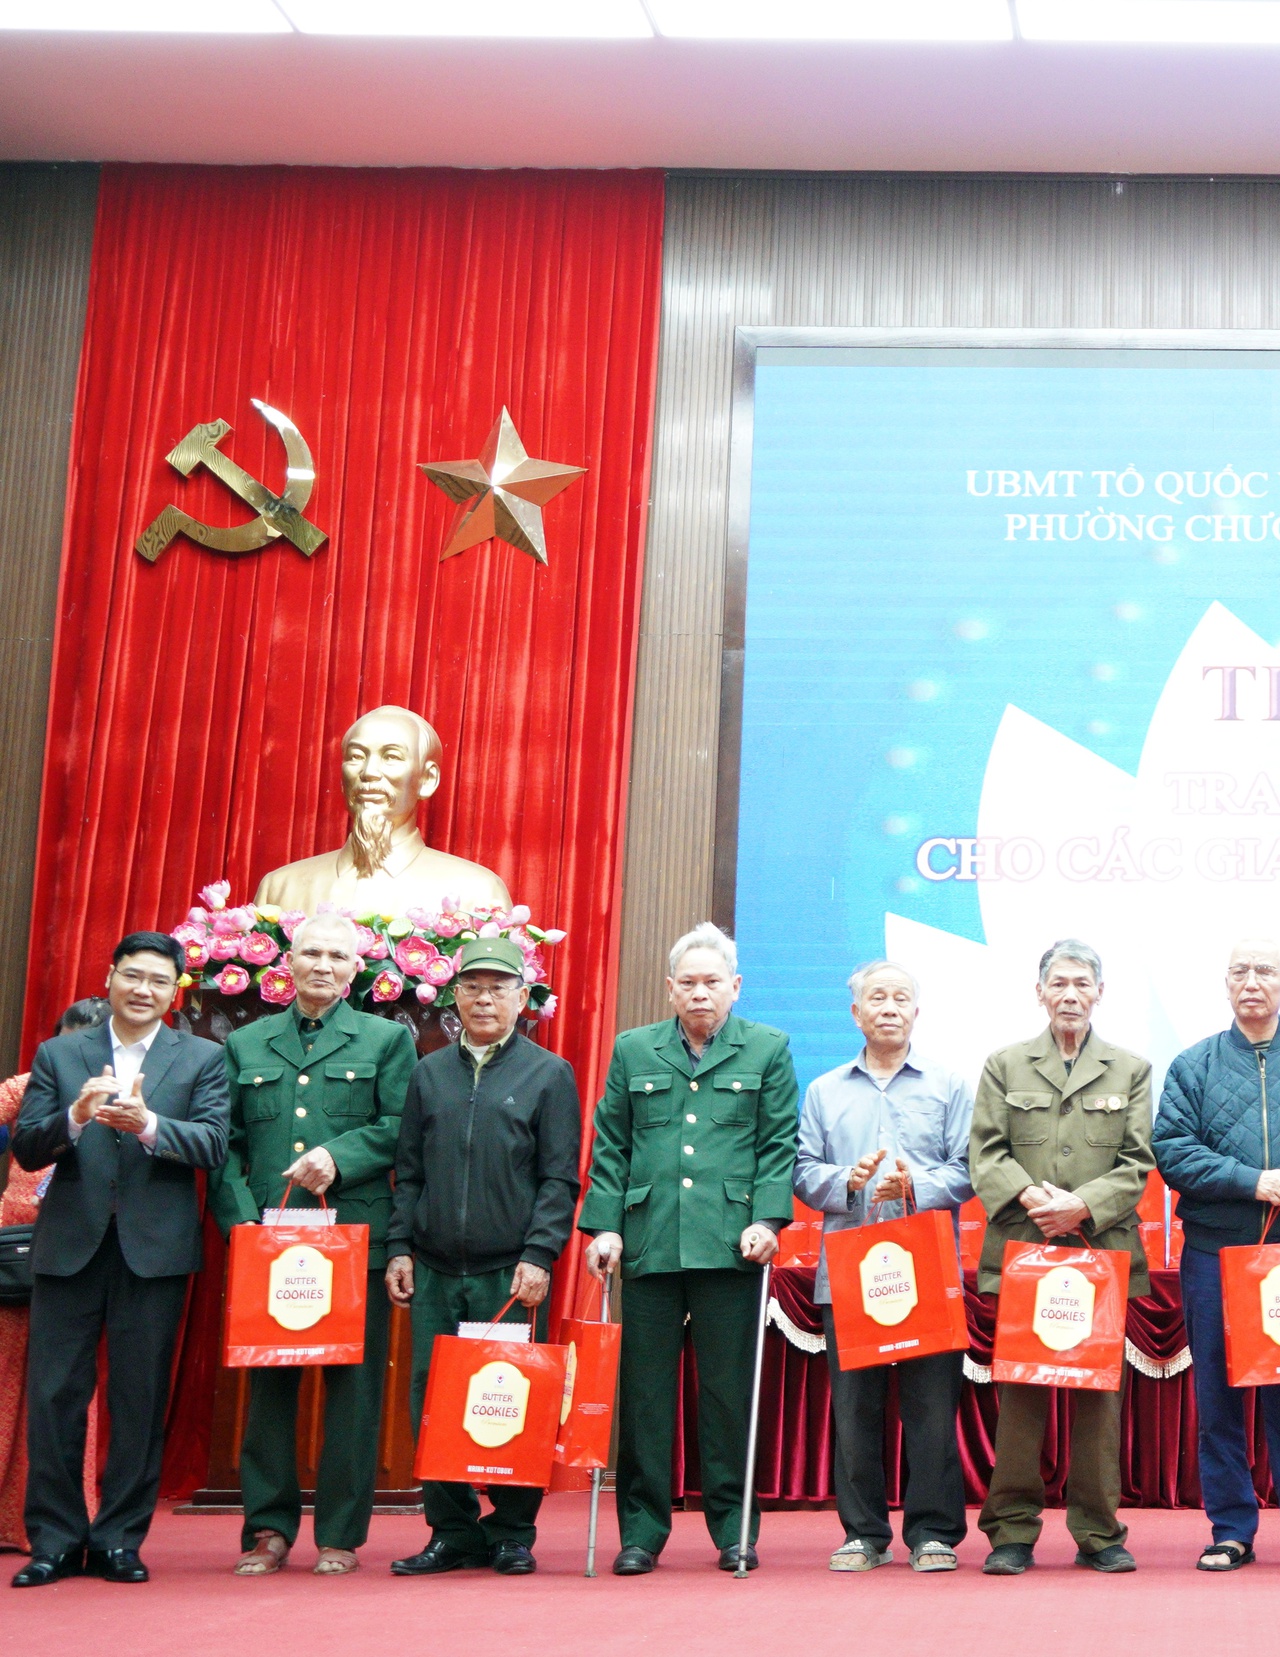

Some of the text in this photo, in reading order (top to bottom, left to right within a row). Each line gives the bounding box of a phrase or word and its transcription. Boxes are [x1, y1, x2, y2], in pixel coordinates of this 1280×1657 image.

[966, 470, 1083, 498] UBMT
[1092, 463, 1145, 499] TỔ
[1154, 463, 1269, 505] QUỐC
[1004, 508, 1175, 542] PHƯỜNG
[916, 836, 1045, 882] CHO
[1056, 826, 1182, 882] CÁC
[284, 1277, 317, 1285] BUTTER
[873, 1271, 902, 1283] BUTTER
[276, 1289, 324, 1300] COOKIES
[868, 1282, 911, 1299] COOKIES
[1050, 1297, 1080, 1307] BUTTER
[1040, 1308, 1086, 1322] COOKIES
[482, 1392, 513, 1403] BUTTER
[471, 1404, 519, 1418] COOKIES
